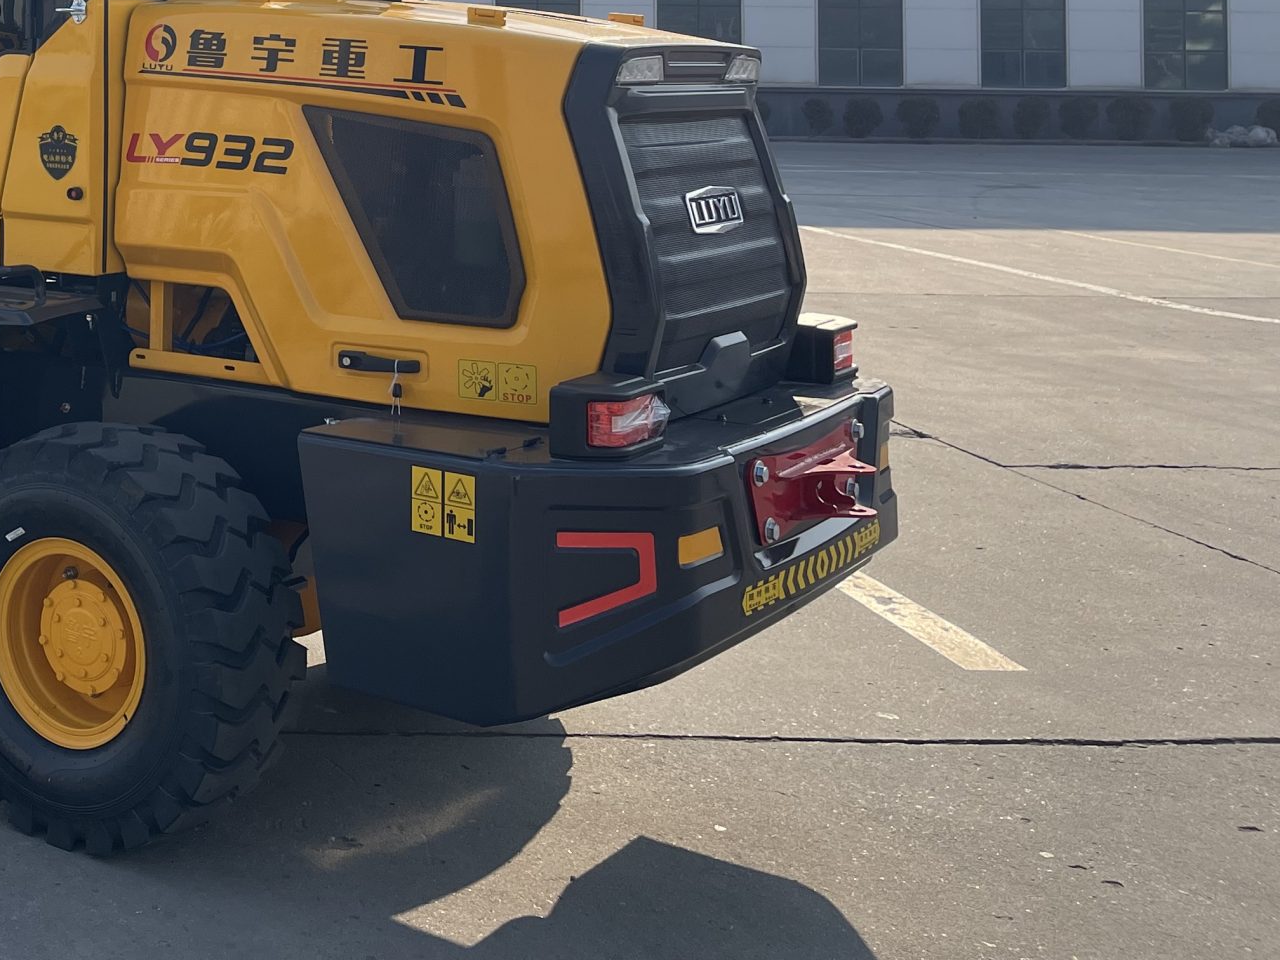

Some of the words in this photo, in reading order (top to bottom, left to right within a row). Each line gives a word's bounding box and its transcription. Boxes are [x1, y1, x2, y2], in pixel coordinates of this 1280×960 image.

[142, 62, 173, 71] LUYU
[186, 29, 444, 86] 鲁宇重工
[126, 131, 295, 175] LY932
[690, 194, 739, 225] LUYU
[502, 392, 532, 403] STOP
